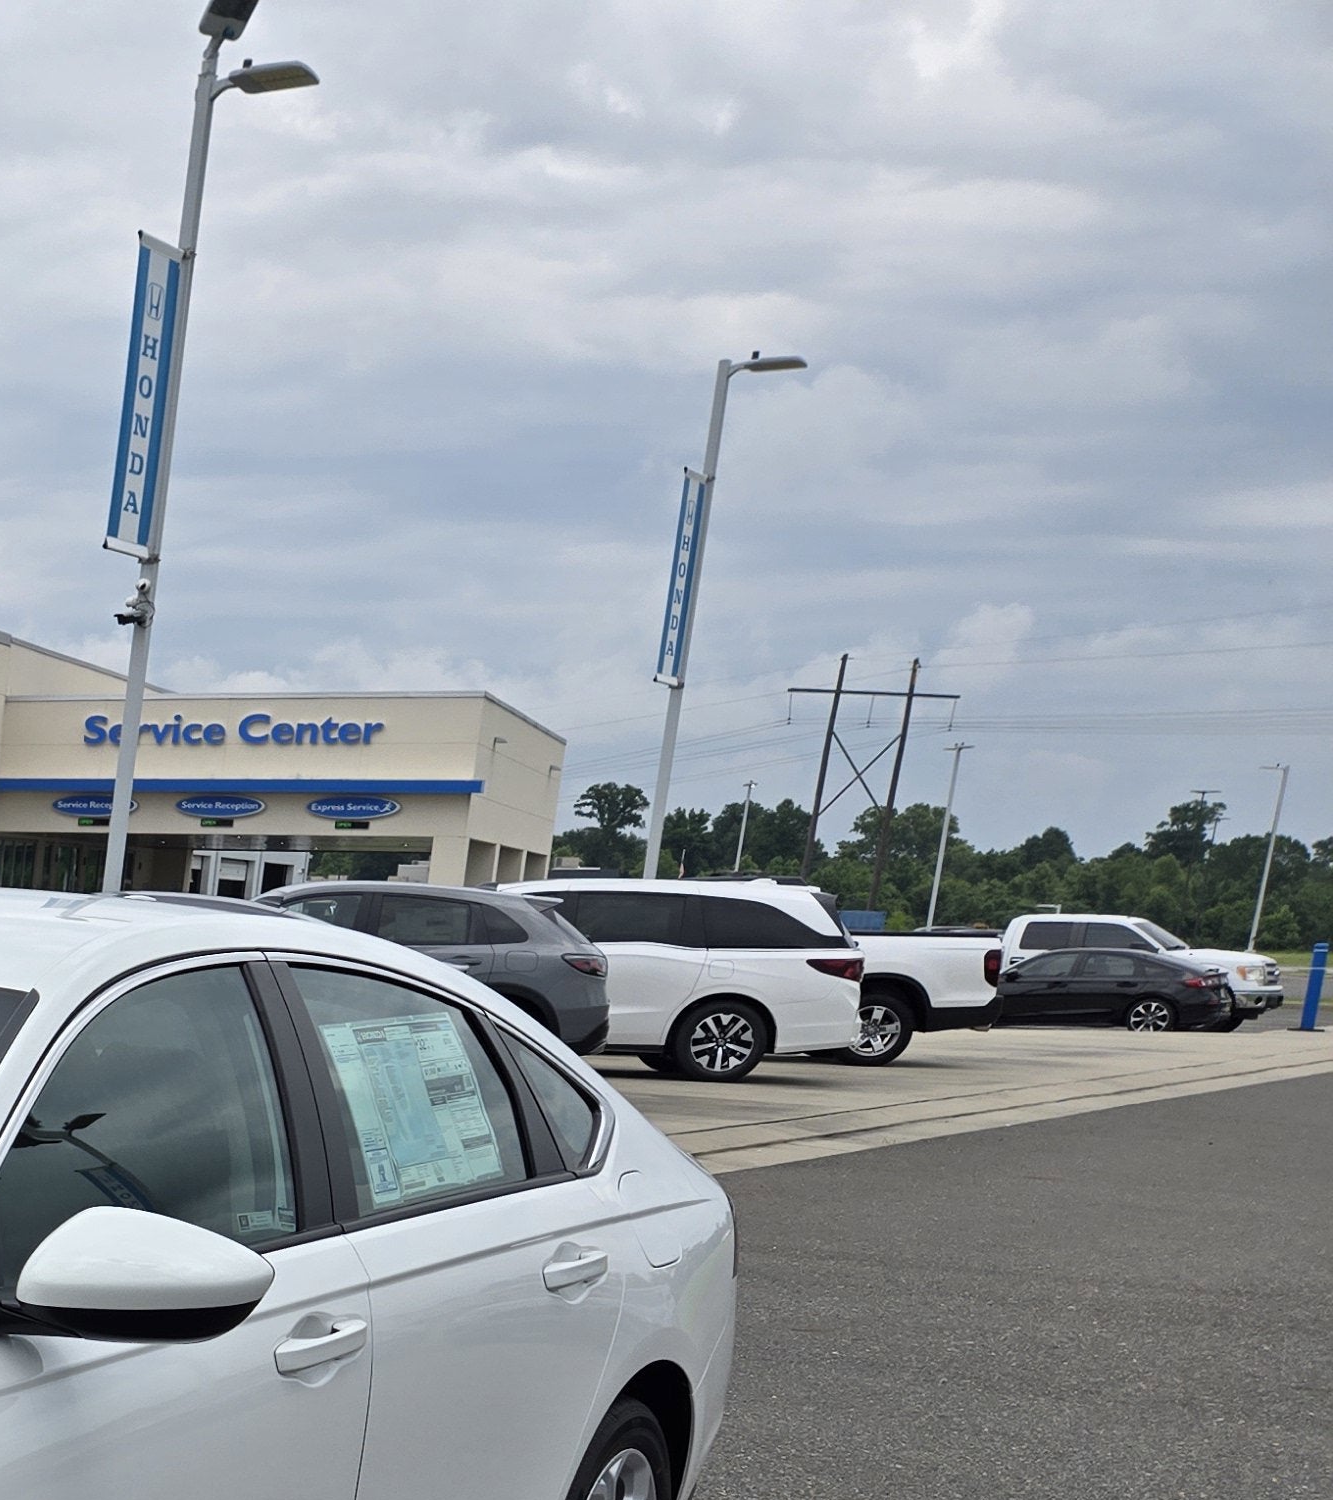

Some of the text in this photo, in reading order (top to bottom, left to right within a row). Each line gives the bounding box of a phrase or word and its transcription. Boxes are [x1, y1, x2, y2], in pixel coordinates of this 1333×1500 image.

[123, 334, 159, 514] HONDA
[83, 713, 384, 746] Service Center
[181, 801, 259, 811] Service Reception
[311, 803, 379, 812] Express Service
